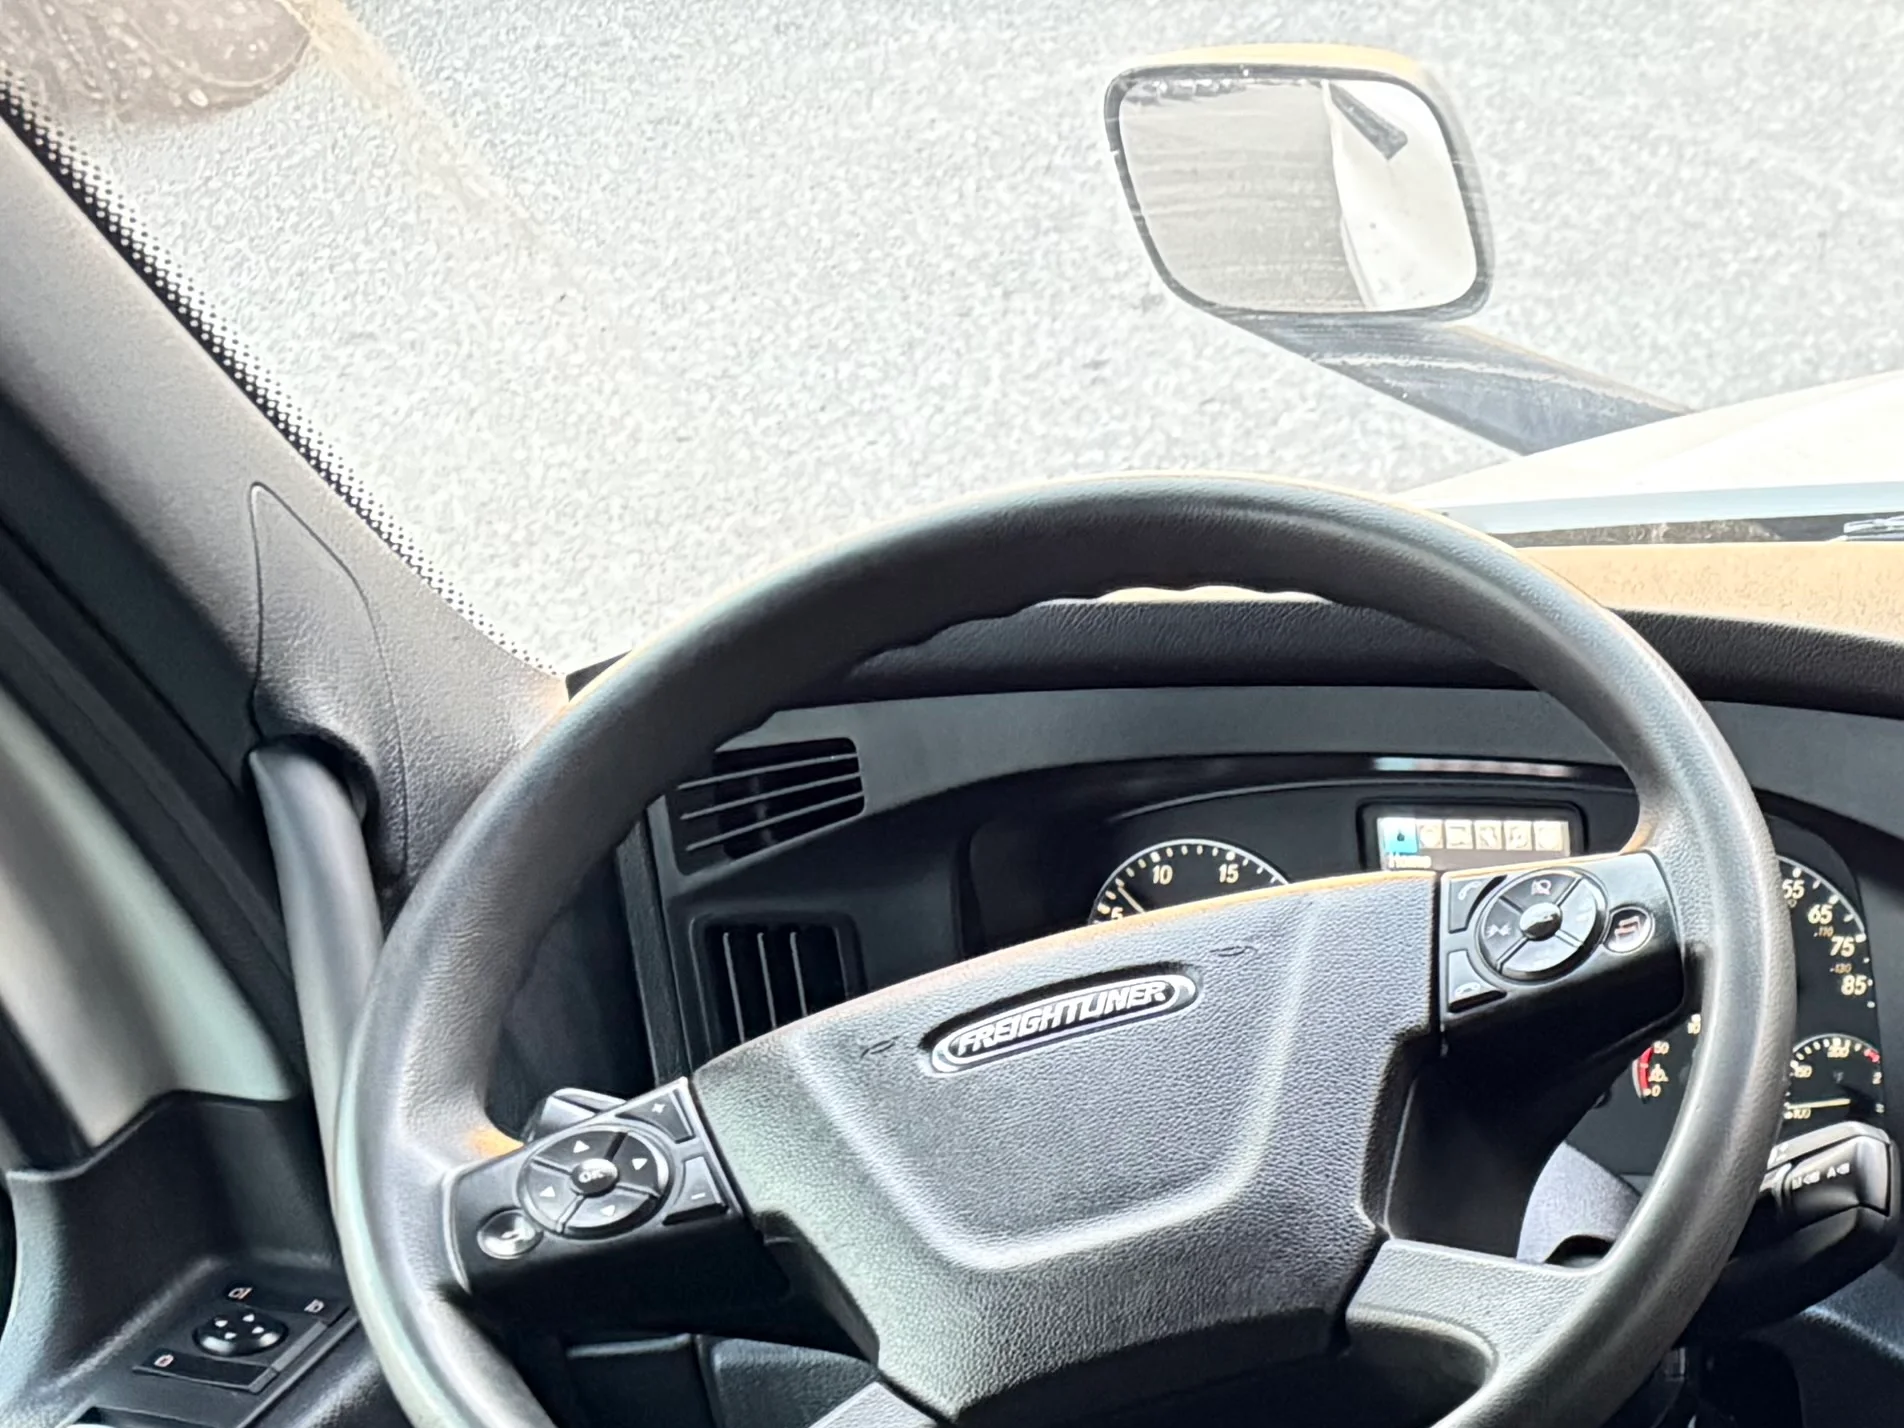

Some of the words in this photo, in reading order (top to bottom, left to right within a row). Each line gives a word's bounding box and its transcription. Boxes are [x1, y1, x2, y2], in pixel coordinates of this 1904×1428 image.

[1152, 864, 1173, 885] 10
[1218, 862, 1239, 884] 15
[1781, 878, 1805, 899] 55
[1807, 904, 1833, 925] 65
[1829, 935, 1856, 958] 75
[1840, 973, 1868, 996] 85
[956, 981, 1167, 1057] FREIGHTLINER
